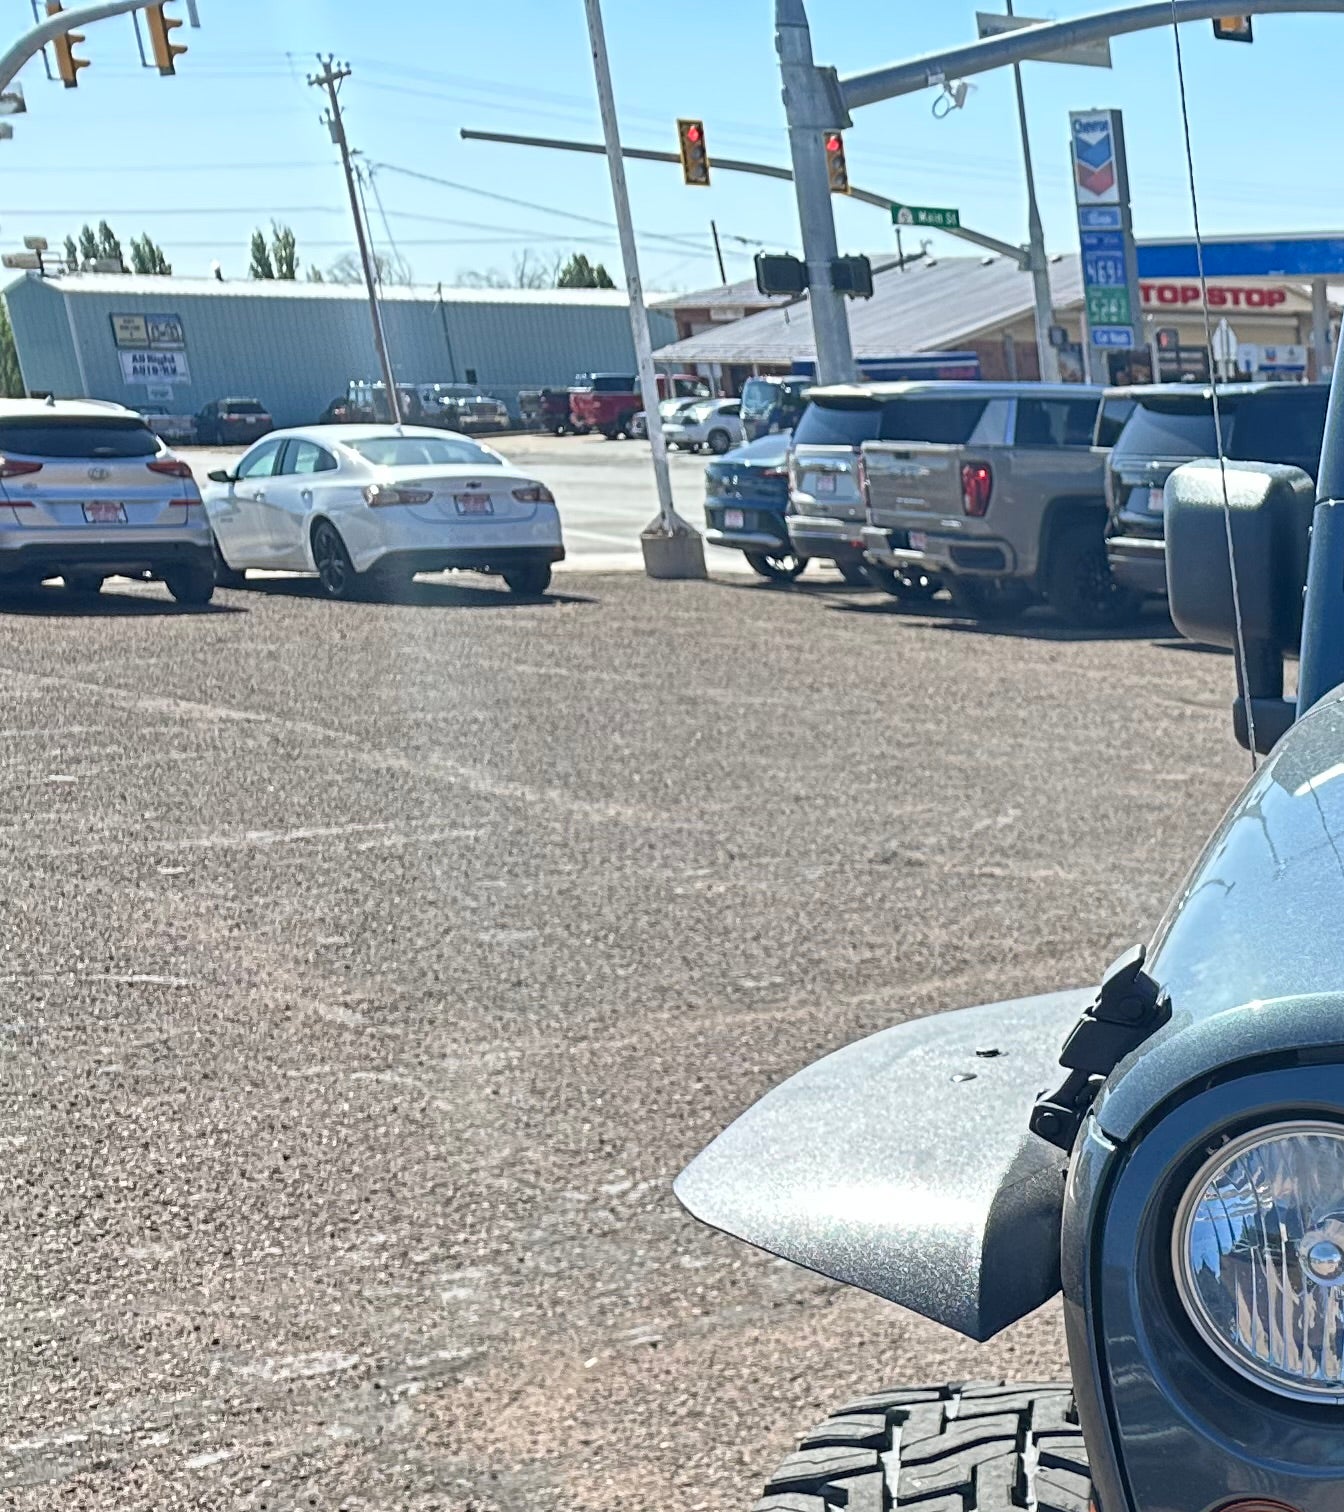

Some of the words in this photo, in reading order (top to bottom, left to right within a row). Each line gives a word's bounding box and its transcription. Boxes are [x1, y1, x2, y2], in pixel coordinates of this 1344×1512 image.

[918, 209, 943, 224] Main
[945, 211, 957, 225] St
[1140, 282, 1200, 304] TOP
[1207, 285, 1286, 307] STOP
